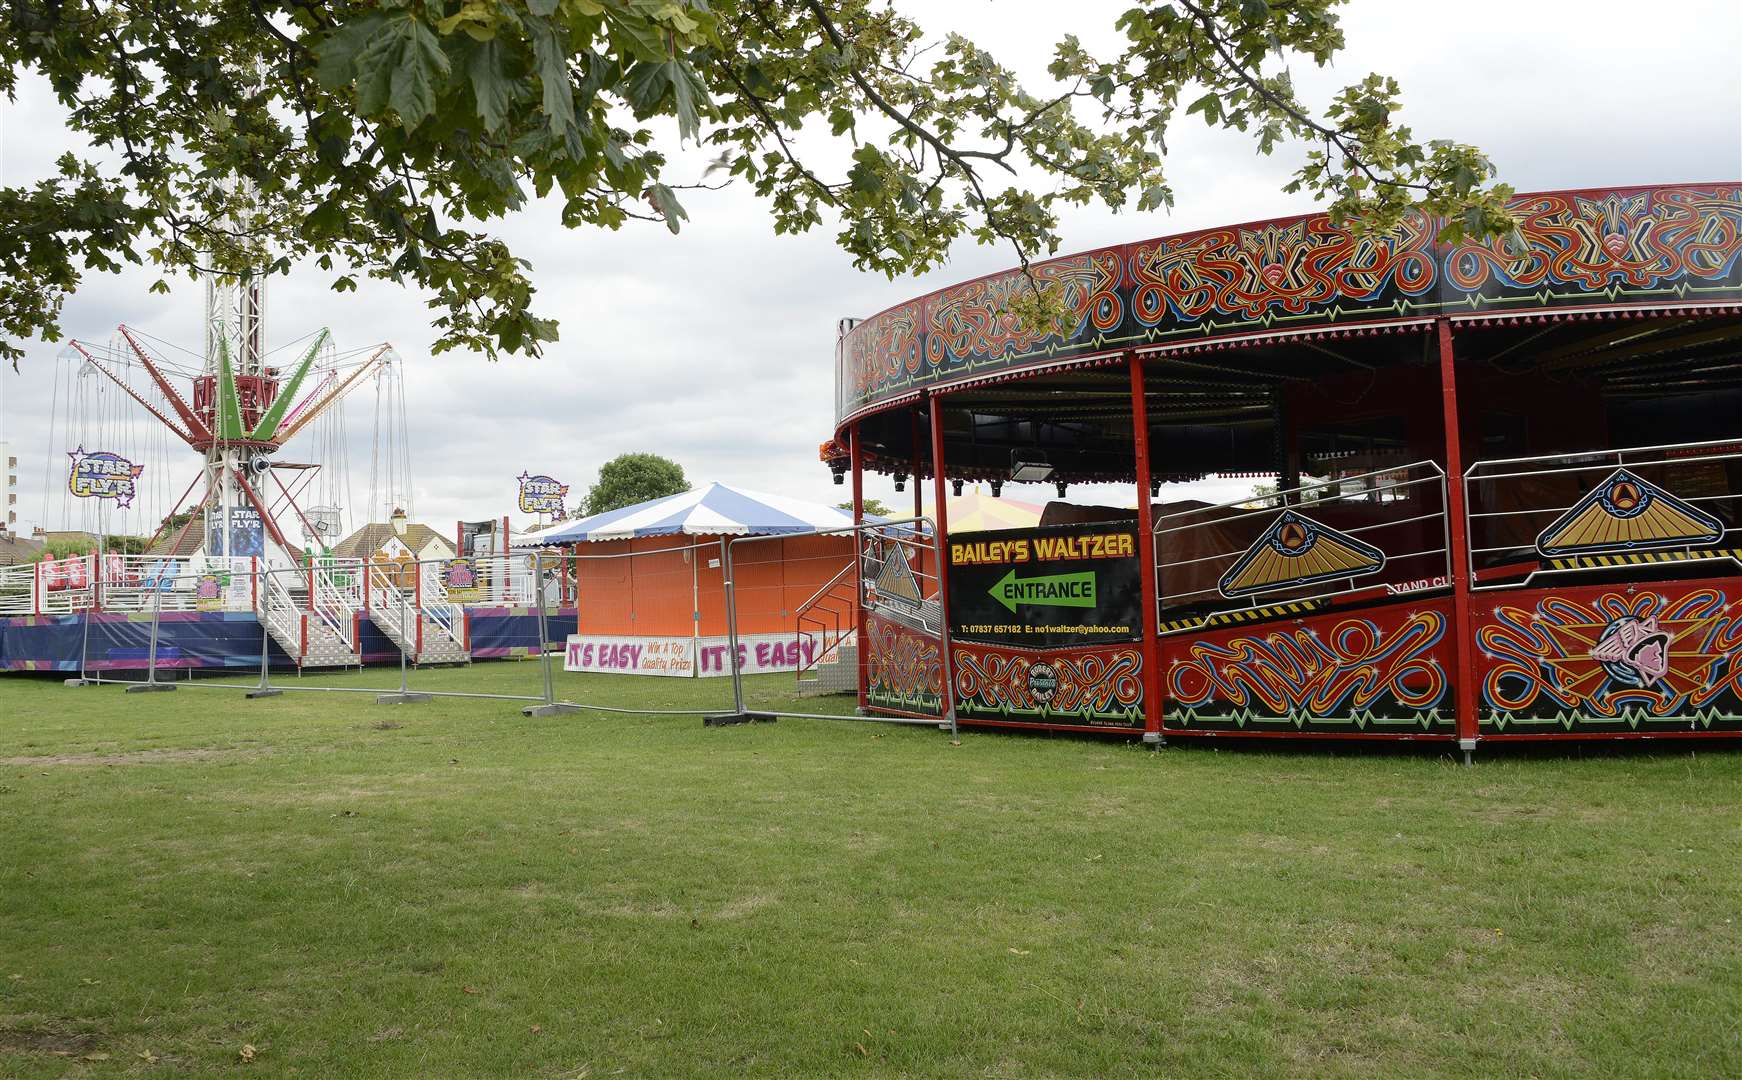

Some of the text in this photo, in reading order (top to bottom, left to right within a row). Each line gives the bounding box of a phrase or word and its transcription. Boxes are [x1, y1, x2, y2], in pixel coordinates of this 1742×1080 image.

[78, 459, 131, 476] STAR
[76, 477, 132, 495] FLY'R
[525, 481, 560, 495] STAR
[231, 510, 260, 519] STAR
[231, 520, 261, 528] FLY'R
[952, 533, 1135, 565] BAILEY'S WALTZER
[1004, 581, 1092, 599] ENTRANCE
[1387, 578, 1429, 596] STAND
[961, 624, 1130, 635] T: 07837 657182 E: no1waltzer@yahoo.com
[568, 643, 643, 670] IT'S EASY
[755, 640, 818, 669] EASY
